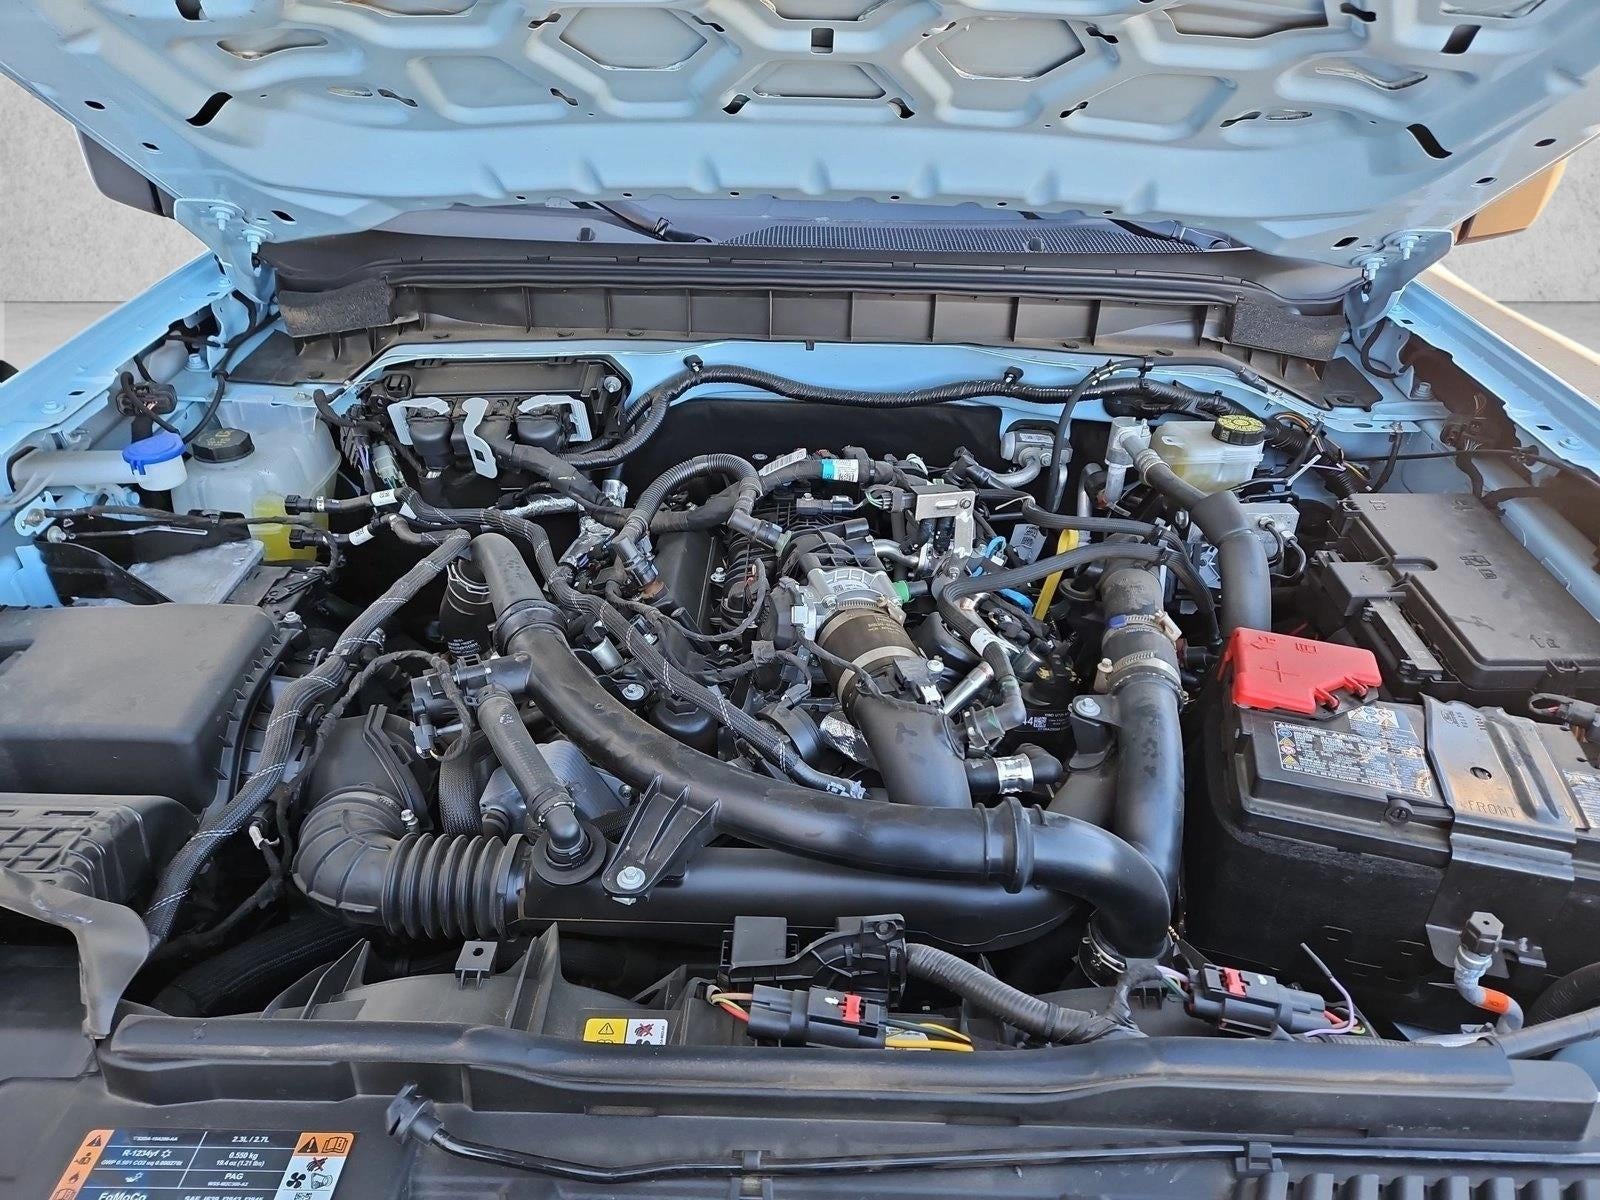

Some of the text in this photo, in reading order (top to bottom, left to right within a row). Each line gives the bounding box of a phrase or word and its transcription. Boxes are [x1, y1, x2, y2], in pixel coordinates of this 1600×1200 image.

[1467, 799, 1516, 818] FRONT
[122, 1149, 160, 1158] R-1234yf
[224, 1172, 244, 1180] PAG
